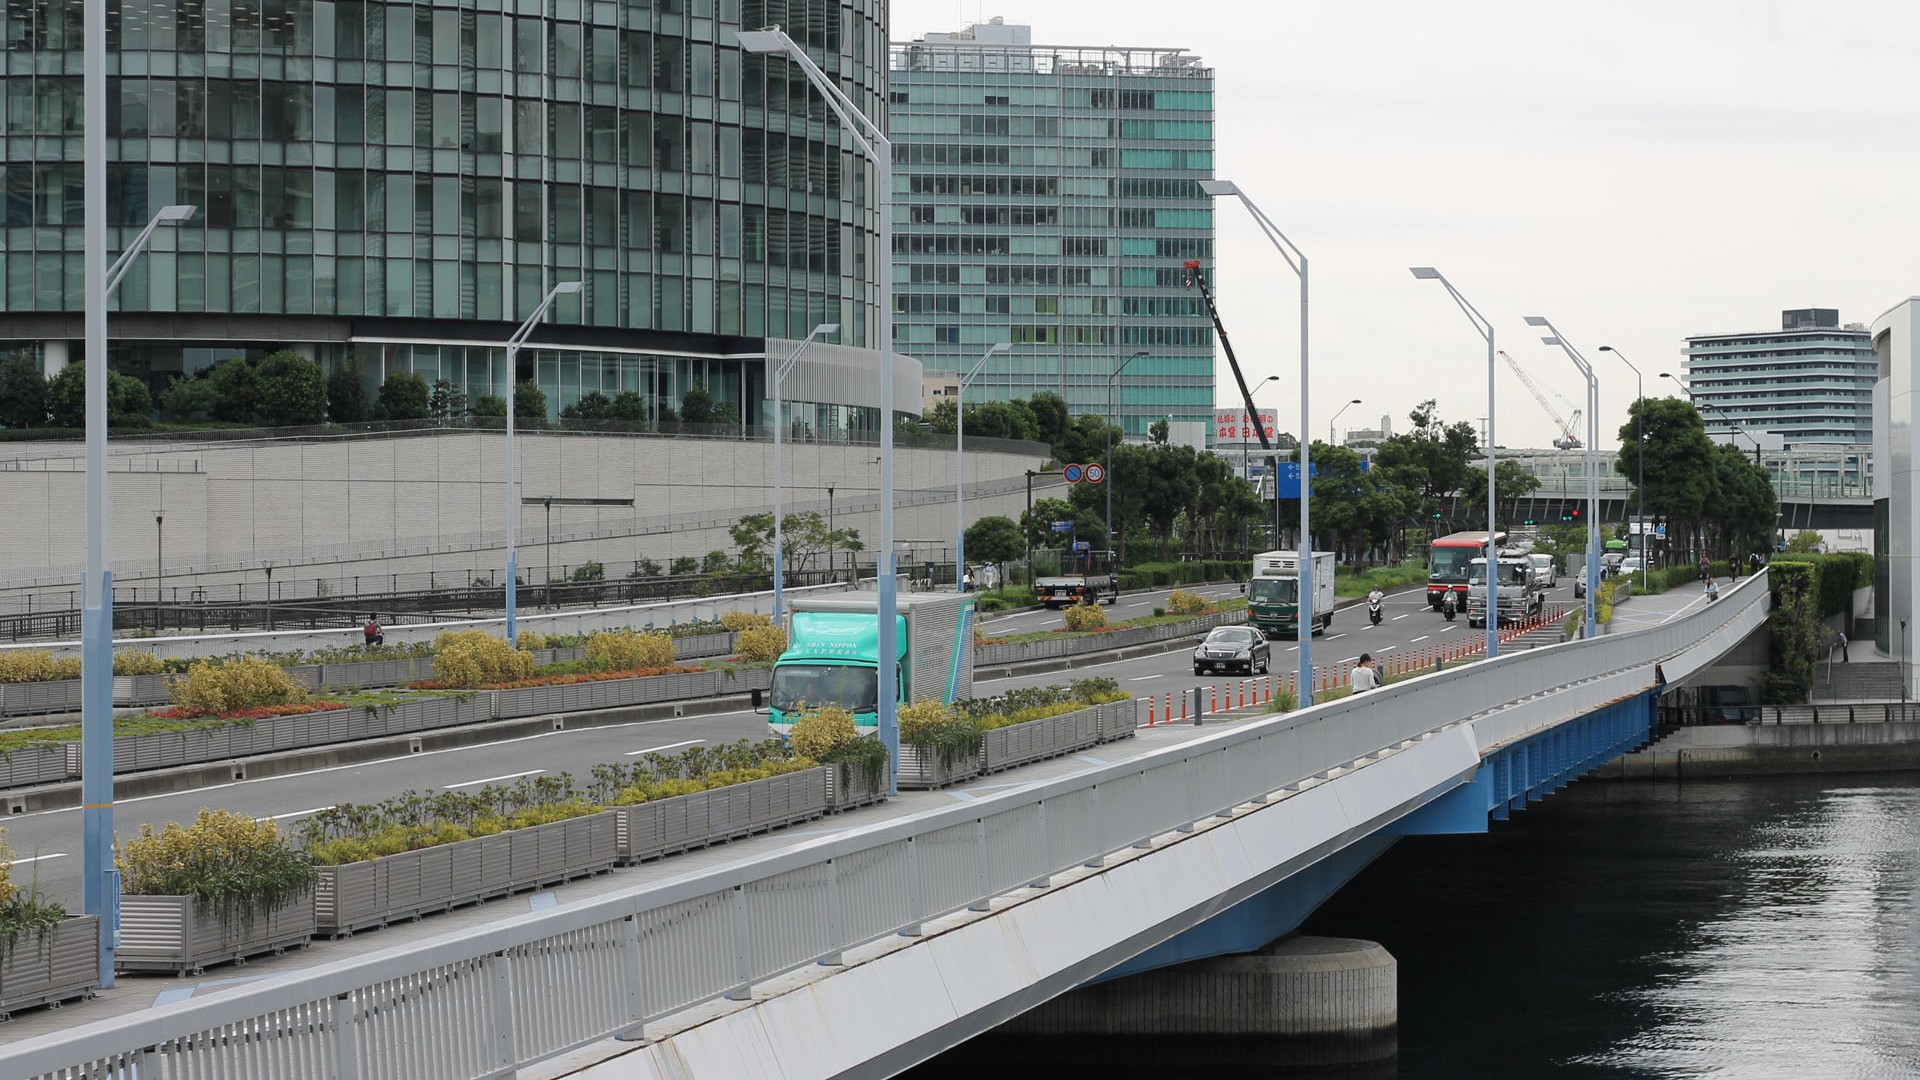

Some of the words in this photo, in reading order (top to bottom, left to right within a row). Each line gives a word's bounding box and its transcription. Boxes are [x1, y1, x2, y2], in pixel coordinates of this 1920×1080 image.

[1242, 414, 1274, 423] お壇の
[1089, 469, 1099, 478] 50
[830, 641, 857, 649] NIPPON
